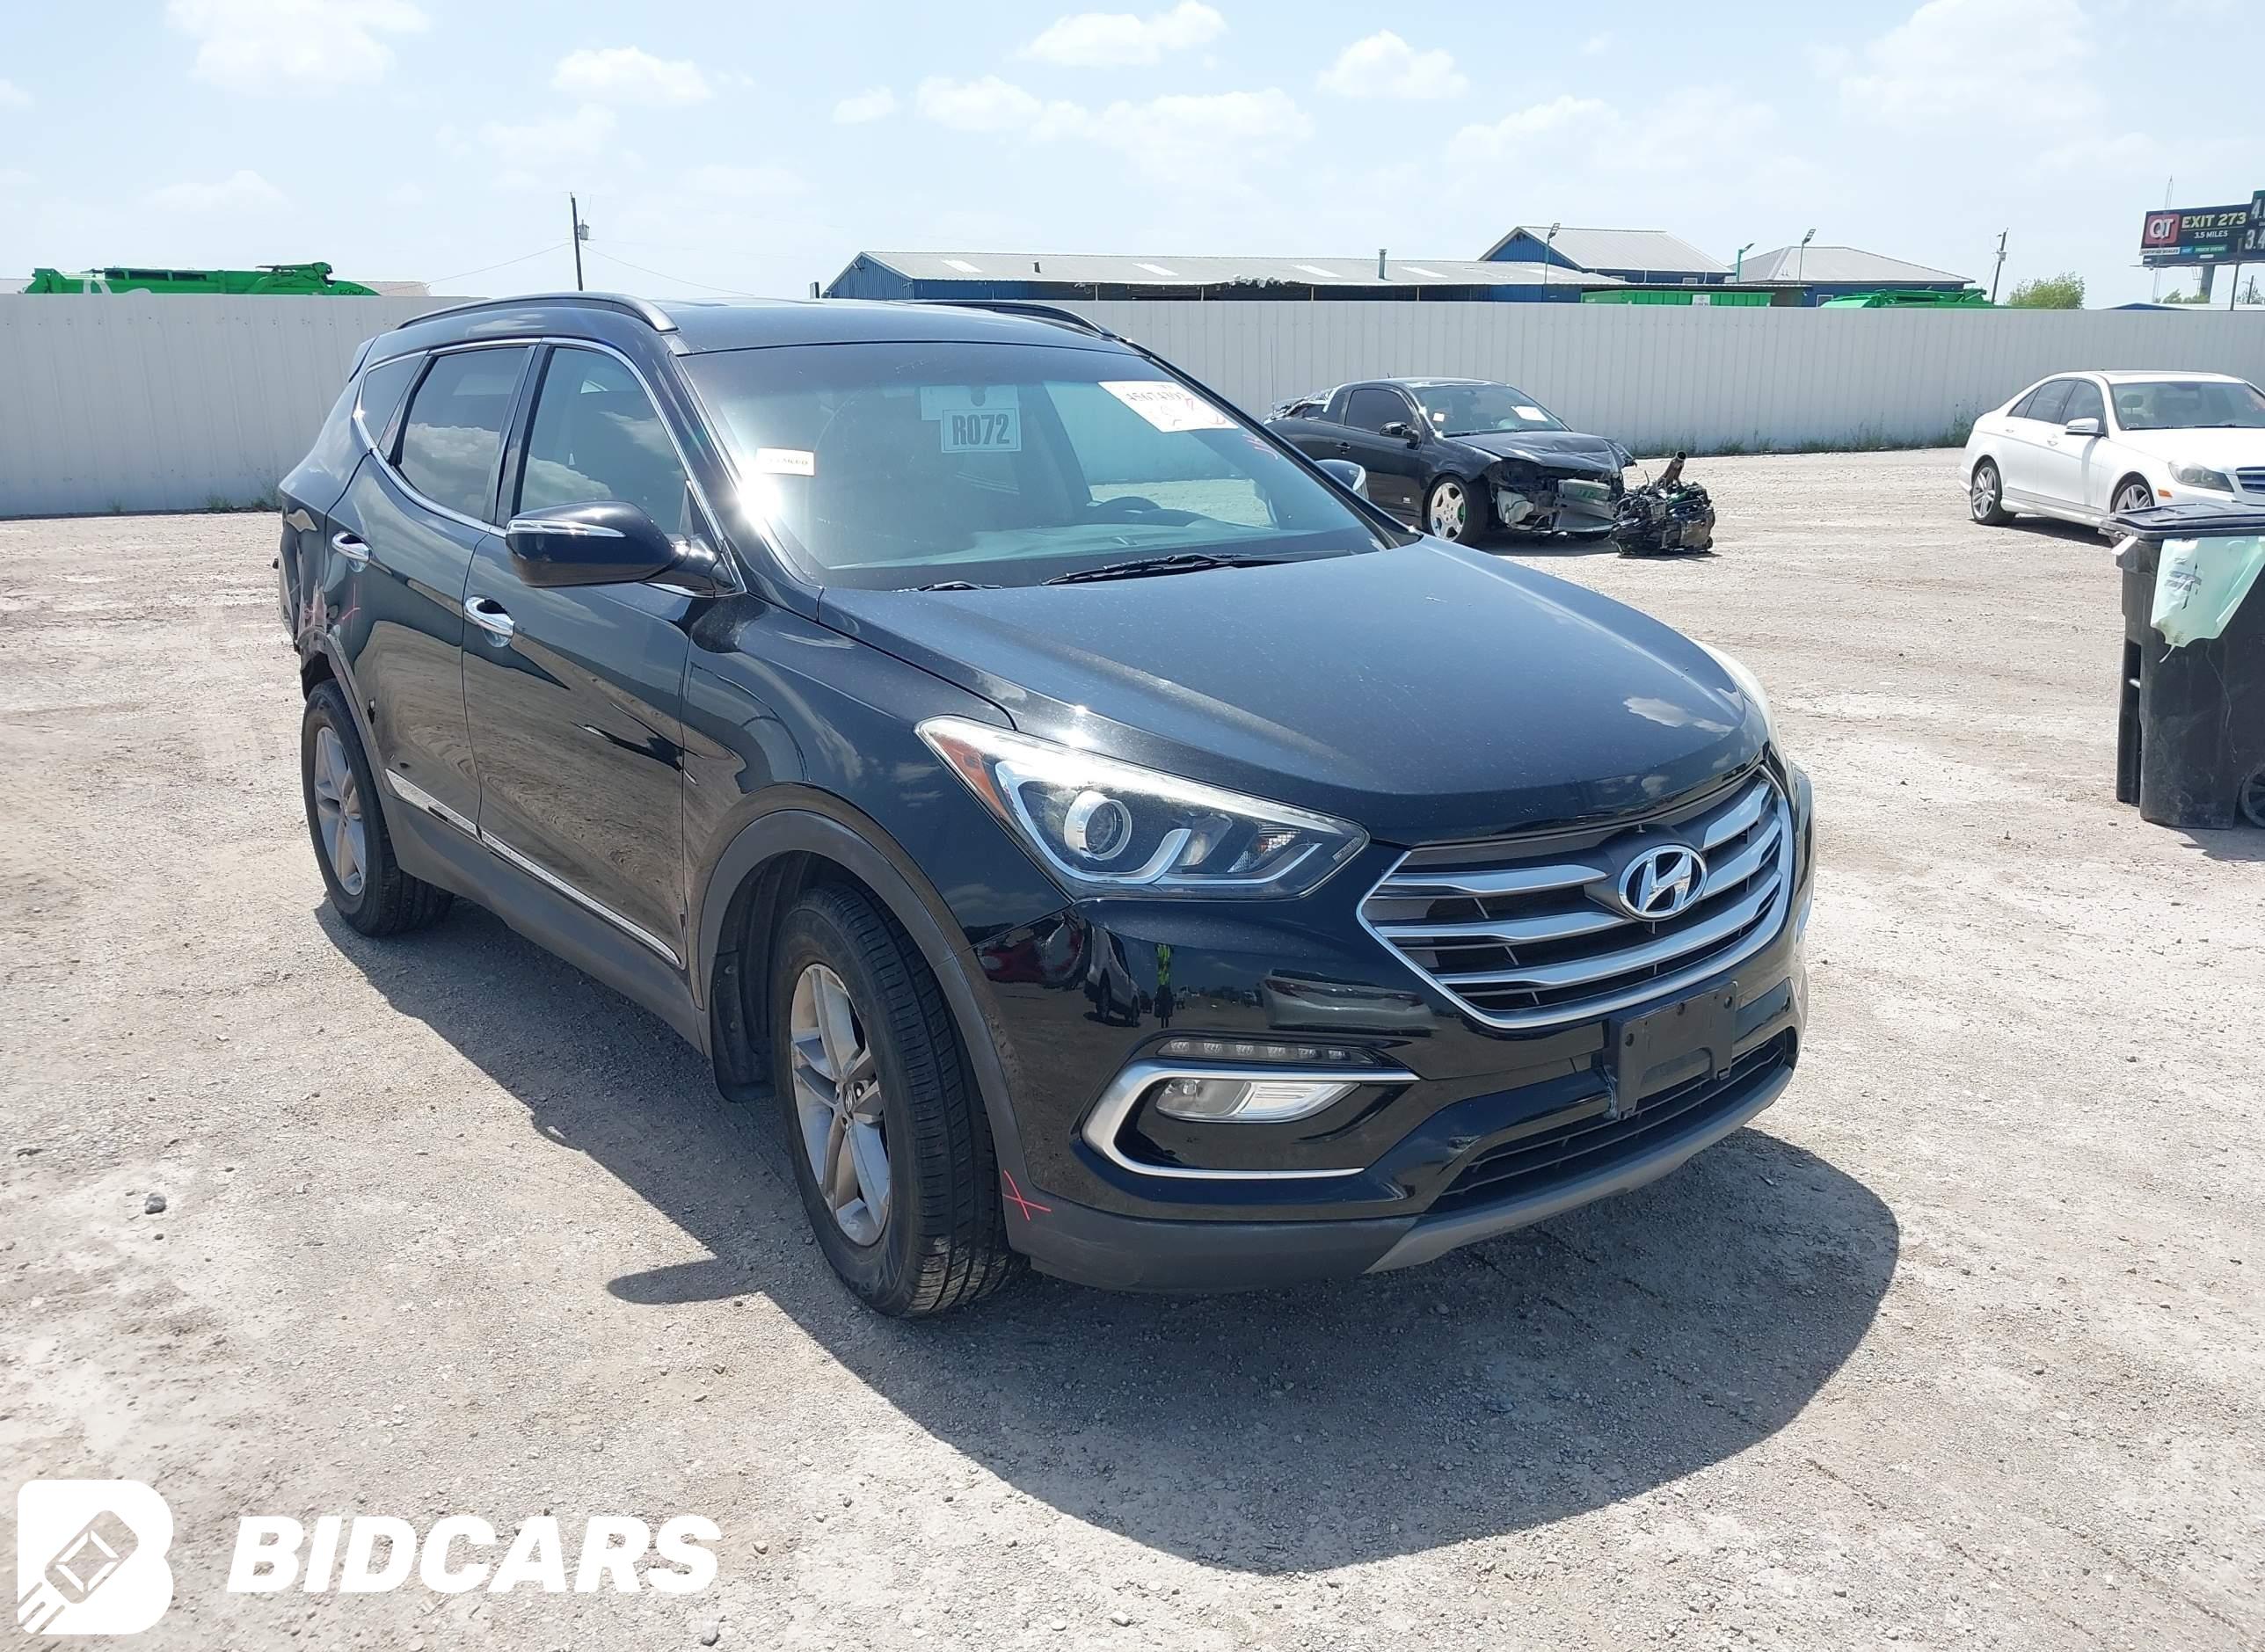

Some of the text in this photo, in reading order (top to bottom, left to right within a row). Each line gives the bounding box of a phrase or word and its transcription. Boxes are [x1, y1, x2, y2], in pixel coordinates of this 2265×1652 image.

[2251, 199, 2265, 219] 4.
[2149, 218, 2174, 239] QT
[2181, 212, 2247, 229] EXIT 273
[951, 413, 1010, 446] R072
